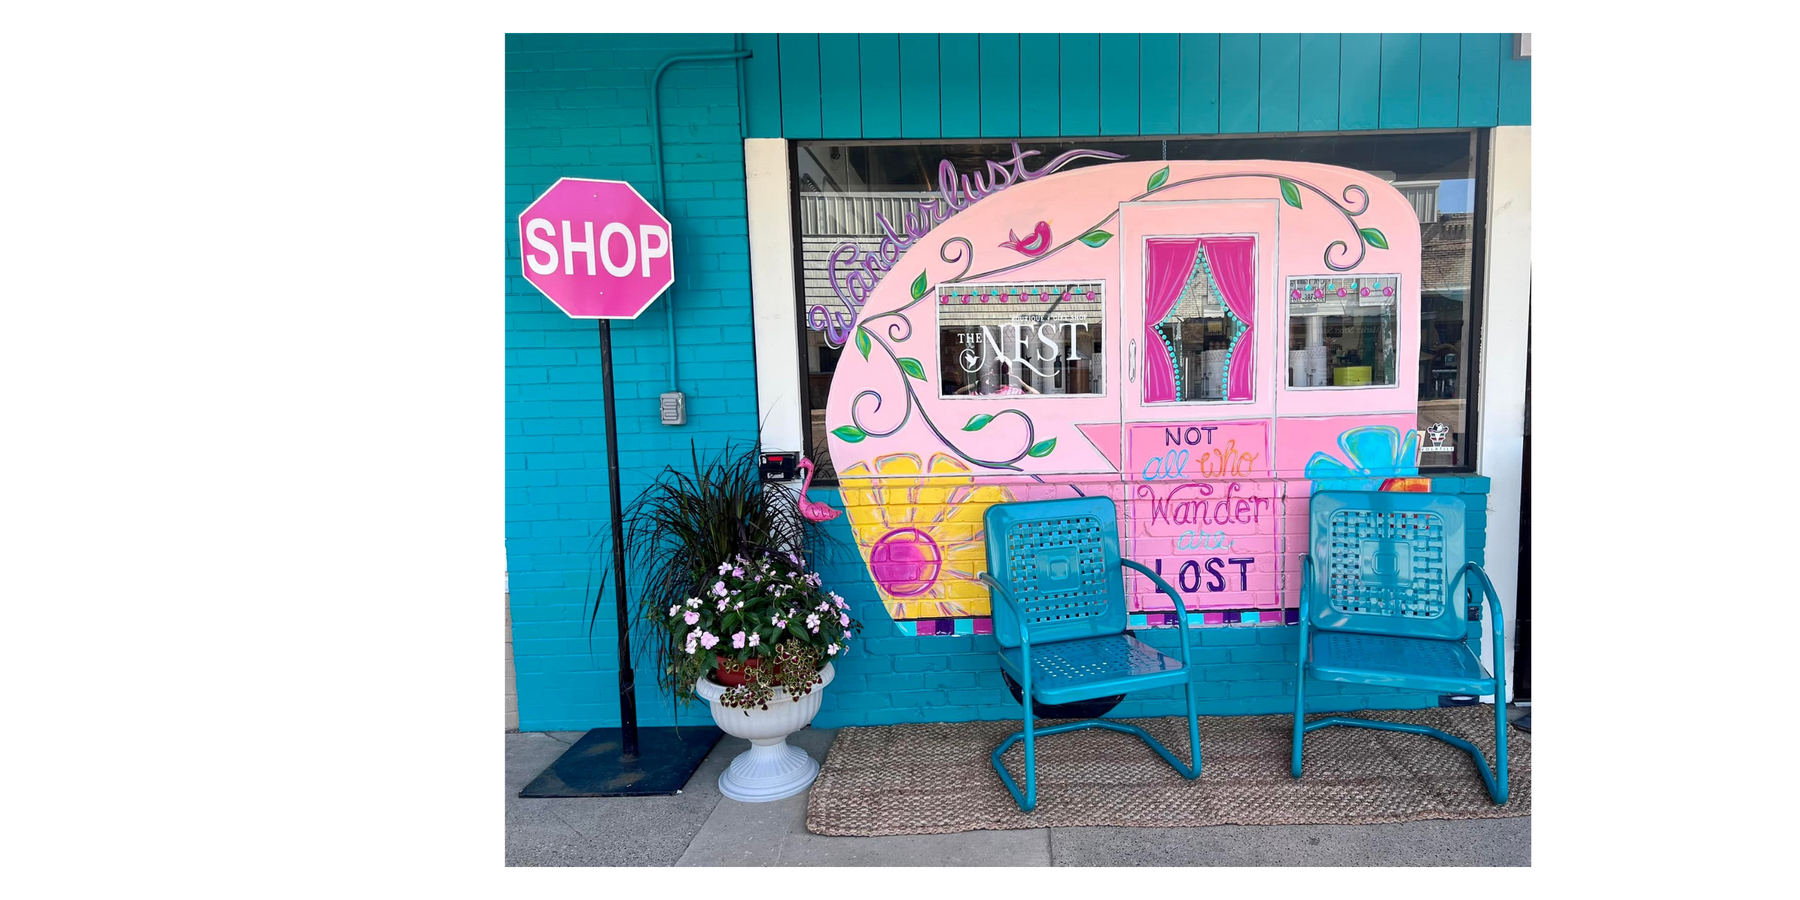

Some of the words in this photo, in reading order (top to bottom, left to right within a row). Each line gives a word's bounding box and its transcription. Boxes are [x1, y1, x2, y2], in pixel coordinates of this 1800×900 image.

[525, 217, 668, 277] SHOP
[808, 141, 1129, 349] Wanderlust
[957, 333, 983, 343] THE
[959, 322, 1089, 377] NEST
[1165, 426, 1218, 446] NOT
[1142, 449, 1190, 481] all
[1196, 439, 1259, 478] who
[1137, 482, 1269, 526] Wander
[1177, 530, 1235, 550] are
[1155, 557, 1254, 593] LOST
